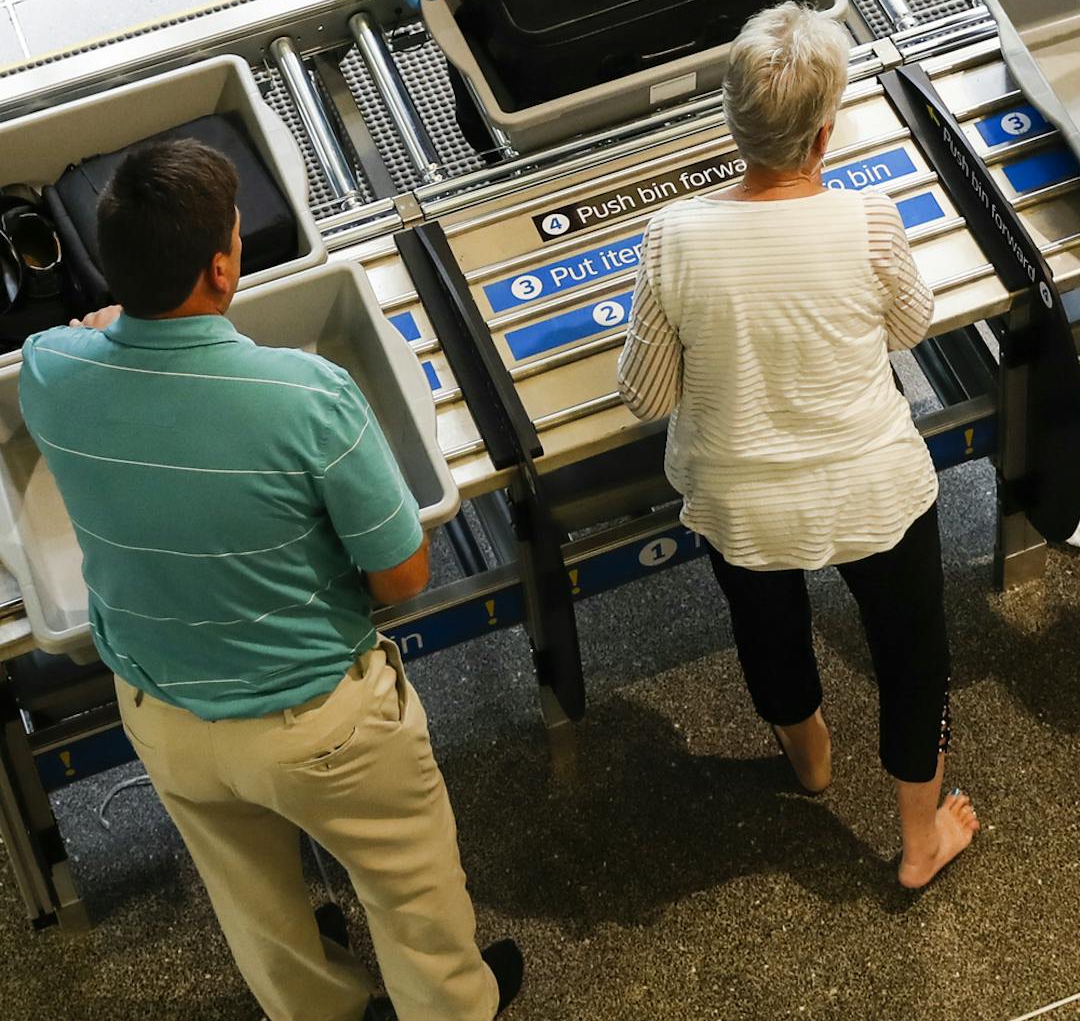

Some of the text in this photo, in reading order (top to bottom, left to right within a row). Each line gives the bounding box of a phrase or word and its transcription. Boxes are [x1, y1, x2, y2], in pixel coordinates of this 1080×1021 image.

[576, 193, 635, 224] Push
[638, 178, 677, 205] bin
[678, 157, 748, 191] forwa
[846, 163, 892, 188] bin
[943, 128, 969, 177] Push
[970, 172, 990, 208] bin
[990, 204, 1036, 282] forward
[550, 257, 598, 288] Put
[599, 243, 643, 270] ite
